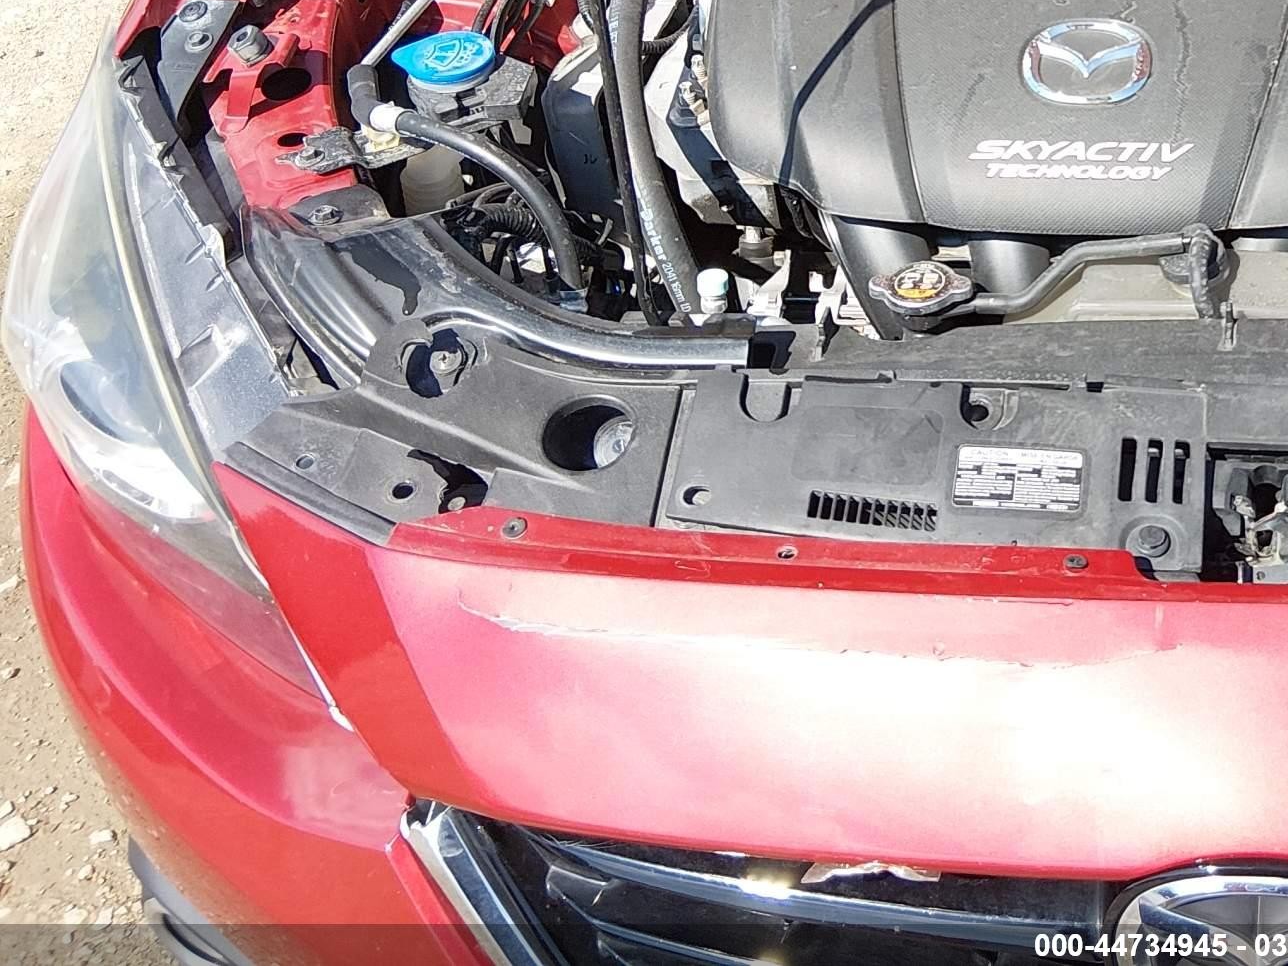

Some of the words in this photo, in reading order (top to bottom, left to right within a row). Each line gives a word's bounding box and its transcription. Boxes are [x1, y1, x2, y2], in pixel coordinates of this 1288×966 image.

[968, 139, 1195, 163] SKYACTIV
[985, 162, 1173, 181] TECHNOLOGY
[640, 207, 667, 261] Parker
